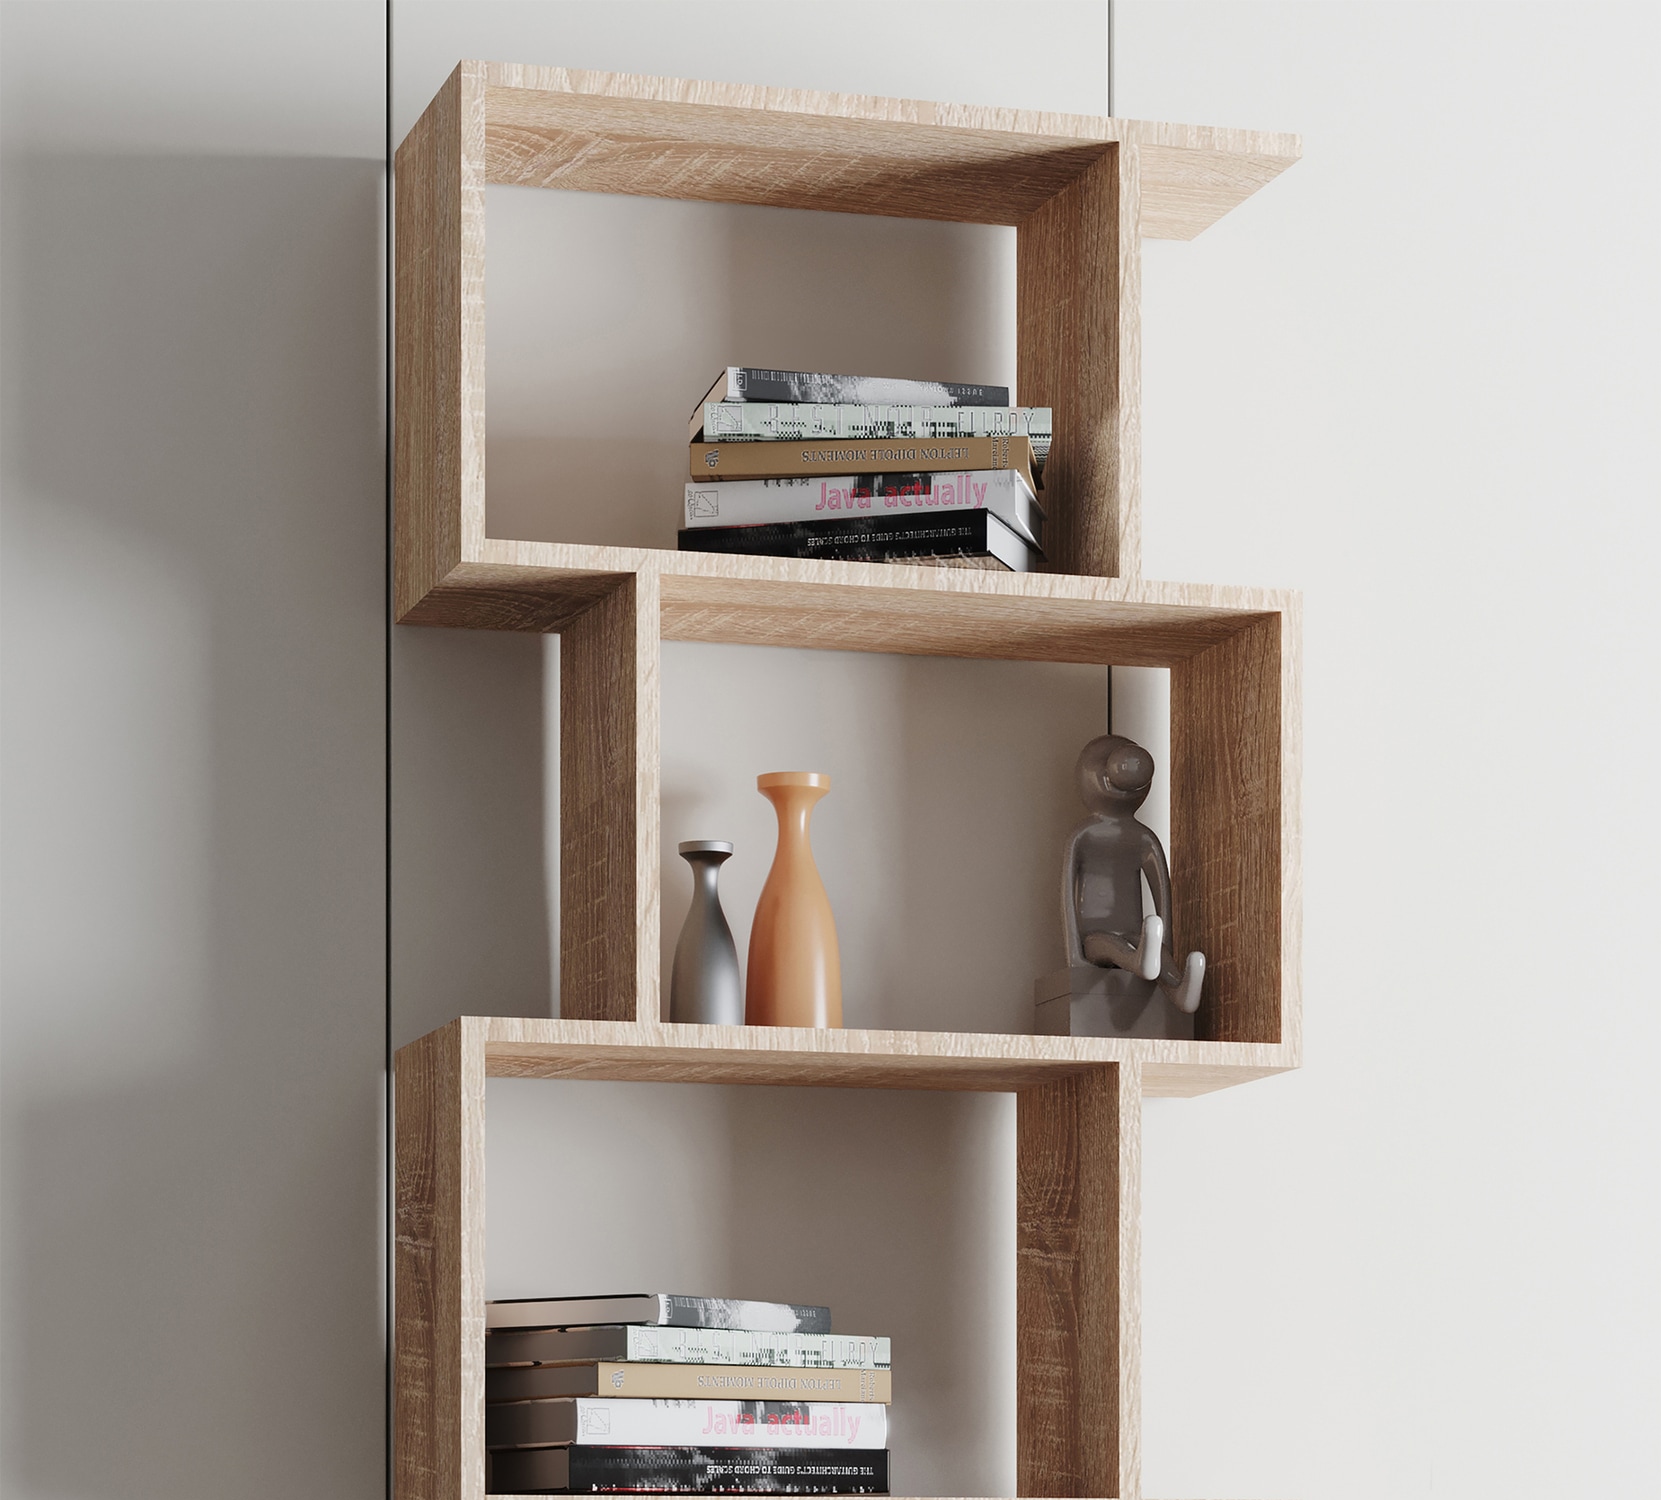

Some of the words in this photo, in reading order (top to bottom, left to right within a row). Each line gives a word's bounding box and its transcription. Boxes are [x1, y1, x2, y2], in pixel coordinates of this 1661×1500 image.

[802, 449, 868, 463] MOMENTS
[872, 448, 918, 461] DIPOLE
[920, 446, 969, 461] LEPTON
[815, 481, 872, 511] Java
[883, 474, 987, 509] actually
[836, 535, 861, 545] CHORD
[862, 533, 872, 542] TO
[872, 532, 895, 541] GUIDE
[698, 1375, 755, 1388] MOMENTS
[758, 1377, 799, 1390] DIPOLE
[801, 1378, 842, 1391] LEPTON
[702, 1405, 755, 1436] Java
[766, 1405, 861, 1444] actually
[707, 1464, 734, 1474] SCALES
[736, 1465, 761, 1475] CHORD
[762, 1466, 773, 1475] TO
[774, 1466, 796, 1475] GUIDE
[861, 1466, 875, 1476] THE
